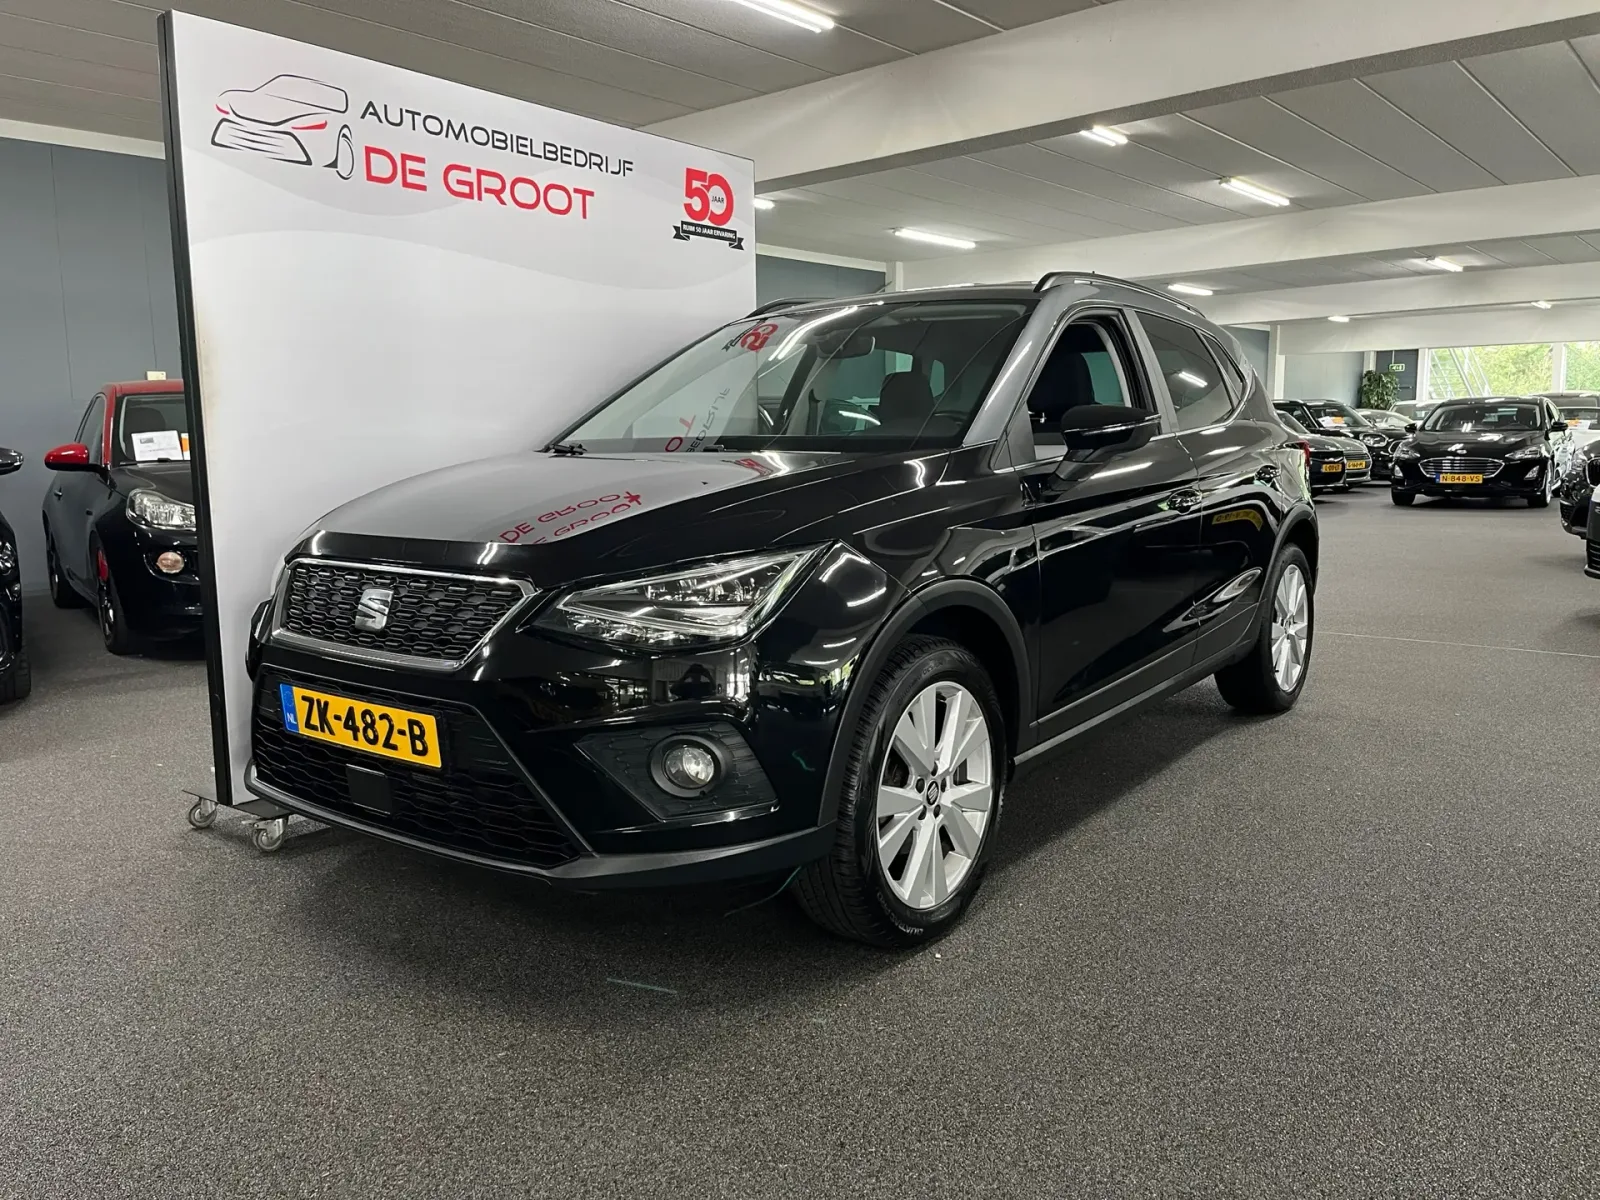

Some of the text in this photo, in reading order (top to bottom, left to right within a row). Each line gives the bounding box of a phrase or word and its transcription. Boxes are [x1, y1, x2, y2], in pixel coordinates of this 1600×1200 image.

[360, 100, 634, 177] AUTOMOBIELBEDRIJF
[364, 145, 595, 220] DE GROOT
[683, 167, 734, 226] 50
[712, 196, 724, 204] JAAR
[714, 230, 736, 239] ERVARING
[286, 712, 298, 725] NL
[301, 695, 429, 757] ZK-482-B
